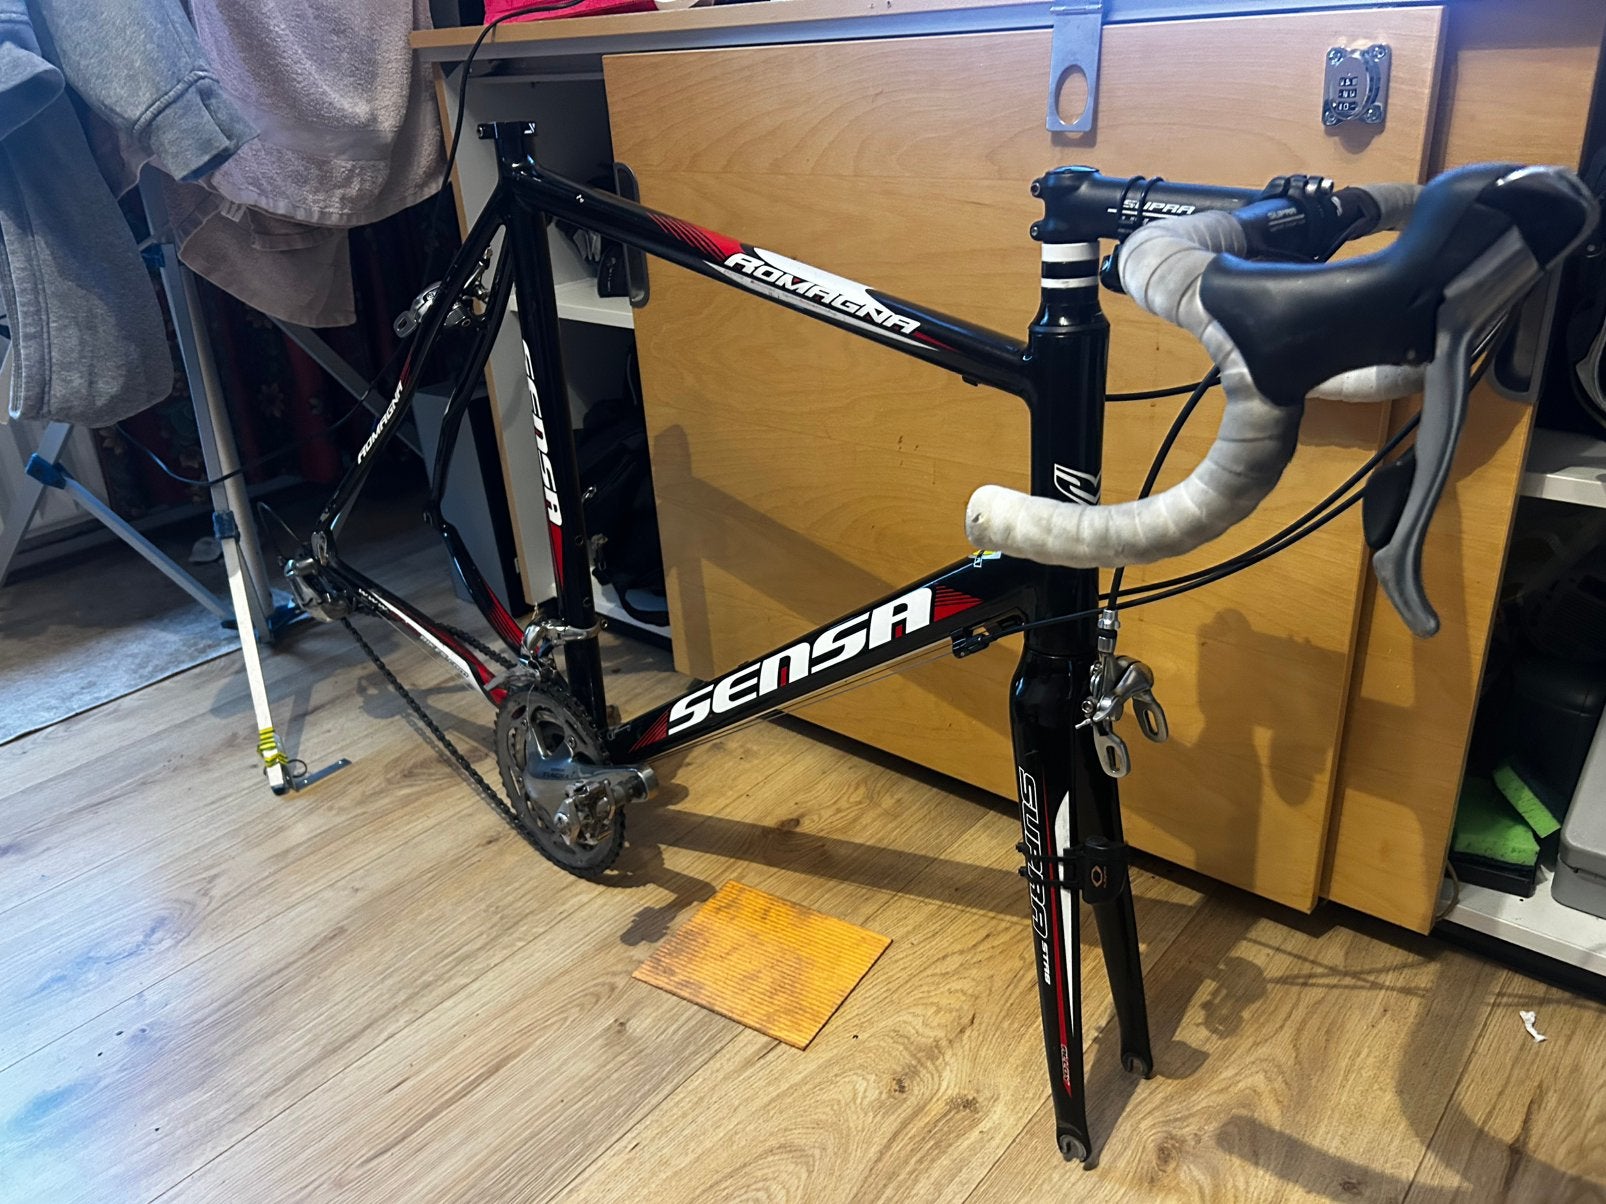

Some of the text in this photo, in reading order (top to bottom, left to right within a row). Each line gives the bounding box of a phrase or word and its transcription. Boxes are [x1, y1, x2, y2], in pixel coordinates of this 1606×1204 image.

[1122, 199, 1196, 215] SUPRA
[724, 252, 921, 335] ROMAGNA
[357, 380, 404, 465] ROMAGNA
[668, 587, 933, 736] SENSA
